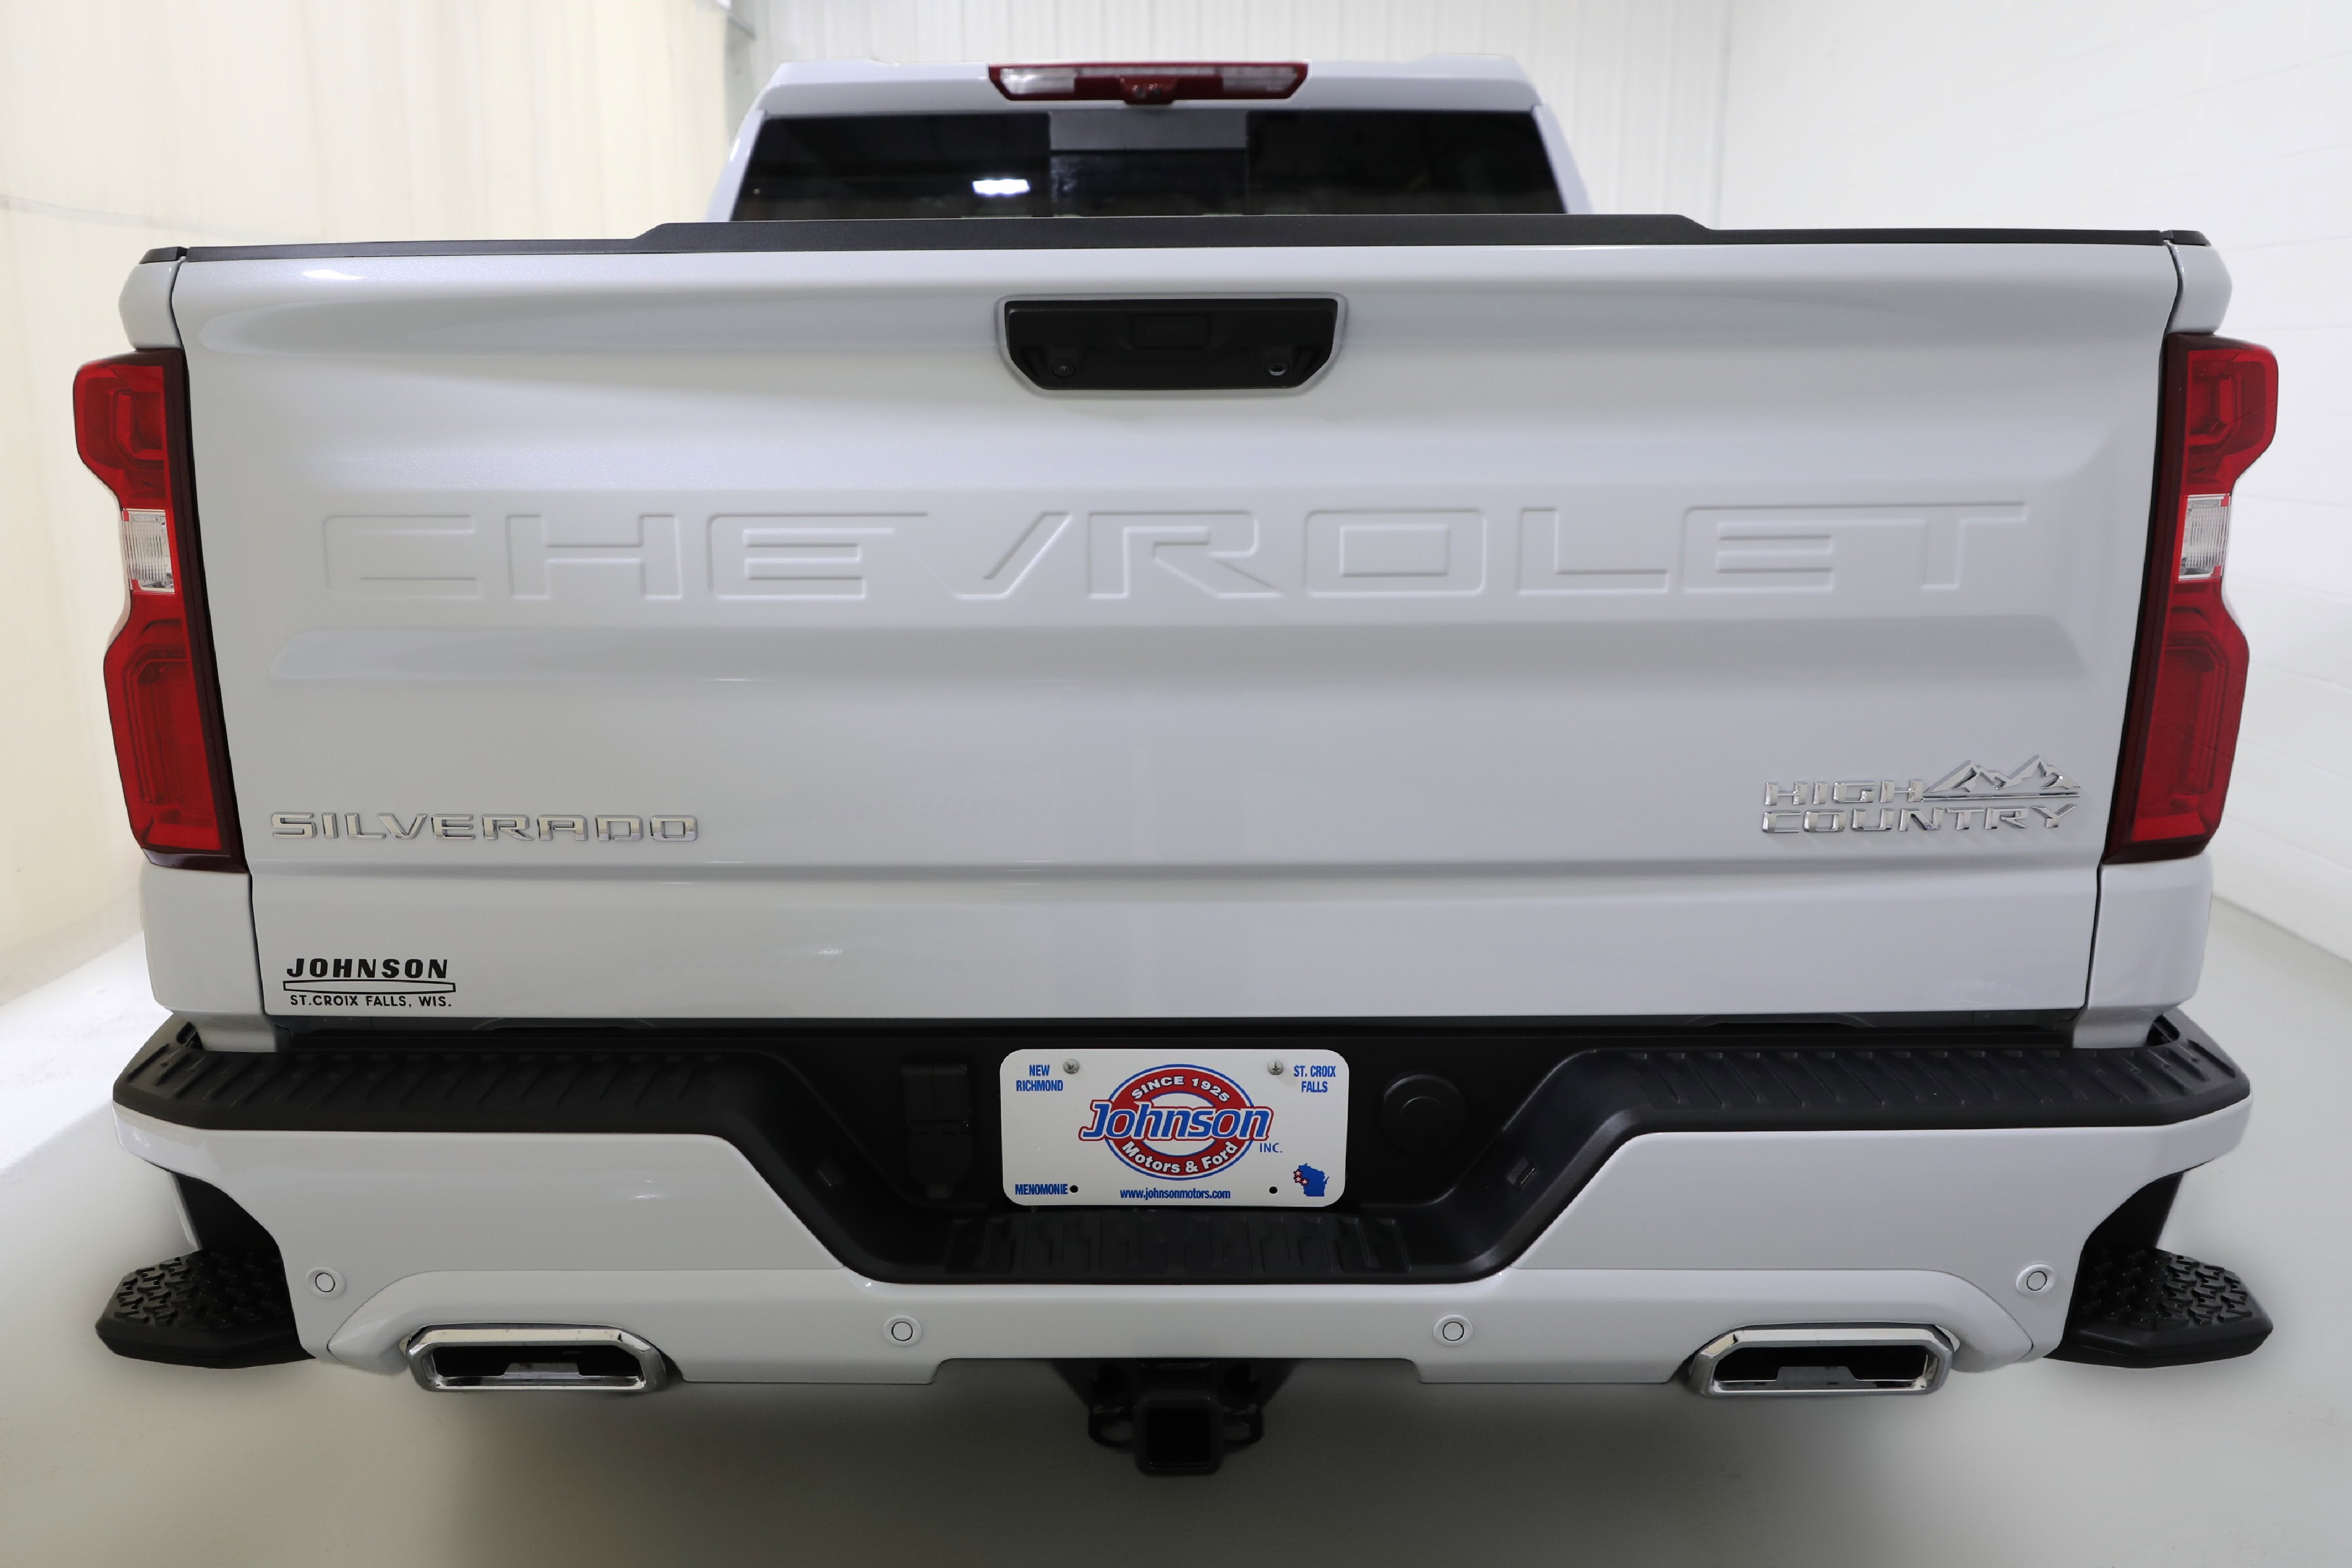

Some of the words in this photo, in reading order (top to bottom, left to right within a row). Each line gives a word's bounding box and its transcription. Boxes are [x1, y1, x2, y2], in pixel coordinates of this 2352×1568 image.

[323, 501, 2027, 600] CHEVROLET
[1765, 779, 1924, 806] HIGH
[1762, 803, 2076, 833] COUNTRY
[270, 812, 698, 841] SILVERADO
[287, 958, 448, 979] JOHNSON
[365, 995, 413, 1007] FALLS,
[418, 996, 452, 1007] WIS.
[1029, 1064, 1050, 1076] NEW
[1293, 1065, 1308, 1077] ST.
[1310, 1065, 1336, 1077] CROIX
[1016, 1080, 1063, 1092] RICHMOND
[1131, 1076, 1184, 1100] SINCE
[1191, 1077, 1230, 1103] 1925
[1301, 1081, 1328, 1093] FALLS
[1080, 1100, 1273, 1141] Johnson
[1259, 1142, 1282, 1153] INC.
[1122, 1141, 1181, 1174] Motors
[1184, 1160, 1199, 1174] &
[1202, 1141, 1238, 1170] Ford
[1015, 1183, 1069, 1195] MENOMONIE
[1120, 1188, 1231, 1200] www.johnsonmotors.com
